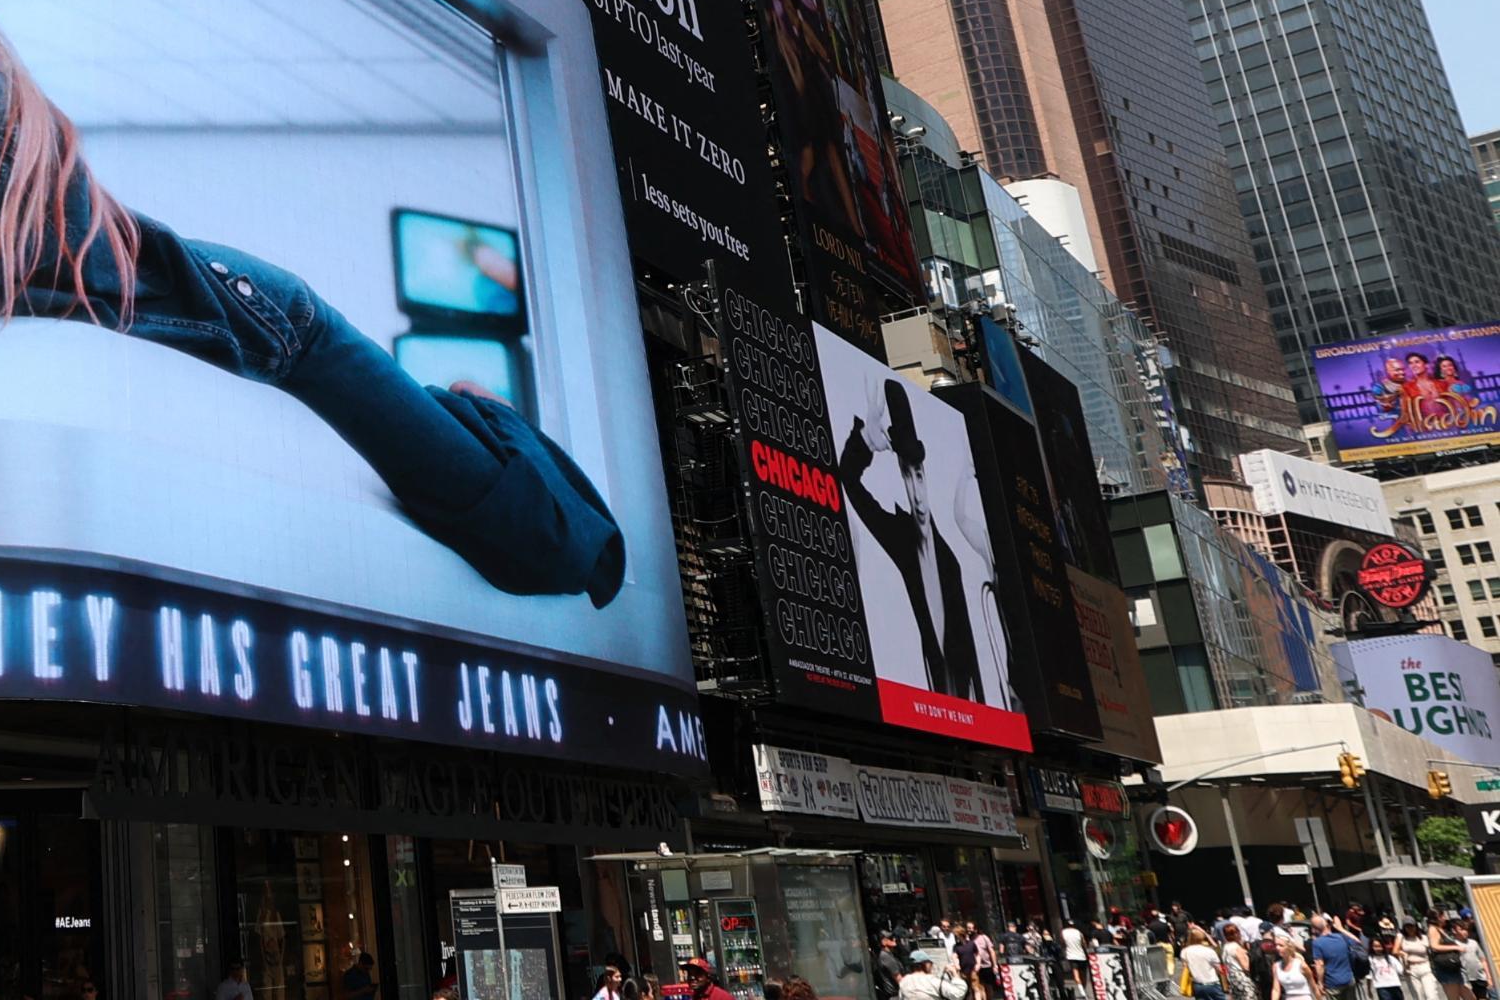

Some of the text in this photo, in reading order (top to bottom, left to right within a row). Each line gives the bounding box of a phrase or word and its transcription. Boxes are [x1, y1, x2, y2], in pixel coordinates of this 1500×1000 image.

[653, 19, 684, 70] last
[684, 49, 716, 93] year
[605, 67, 746, 185] MAKE IT ZERO
[641, 173, 751, 262] less sets you free
[813, 223, 845, 261] LORD
[725, 288, 816, 373] CHICAGO
[1316, 340, 1392, 359] BROADWAY'S
[1395, 333, 1446, 348] MAGICAL
[733, 337, 824, 418] CHICAGO
[741, 388, 832, 467] CHICAGO
[1370, 392, 1497, 438] Aladdin
[751, 439, 841, 514] CHICAGO
[1299, 481, 1380, 513] HYATT REGENCY
[759, 491, 850, 564] CHICAGO
[768, 544, 859, 614] CHICAGO
[776, 598, 867, 665] CHICAGO
[1401, 657, 1422, 670] the
[159, 606, 254, 701] HAS
[291, 629, 420, 723] GREAT
[457, 662, 563, 743] JEANS
[913, 701, 974, 726] WHY DON'T WE PAINT
[99, 726, 679, 834] AMERICAN EAGLE OUTFITTERS
[55, 917, 92, 928] #AEJeans
